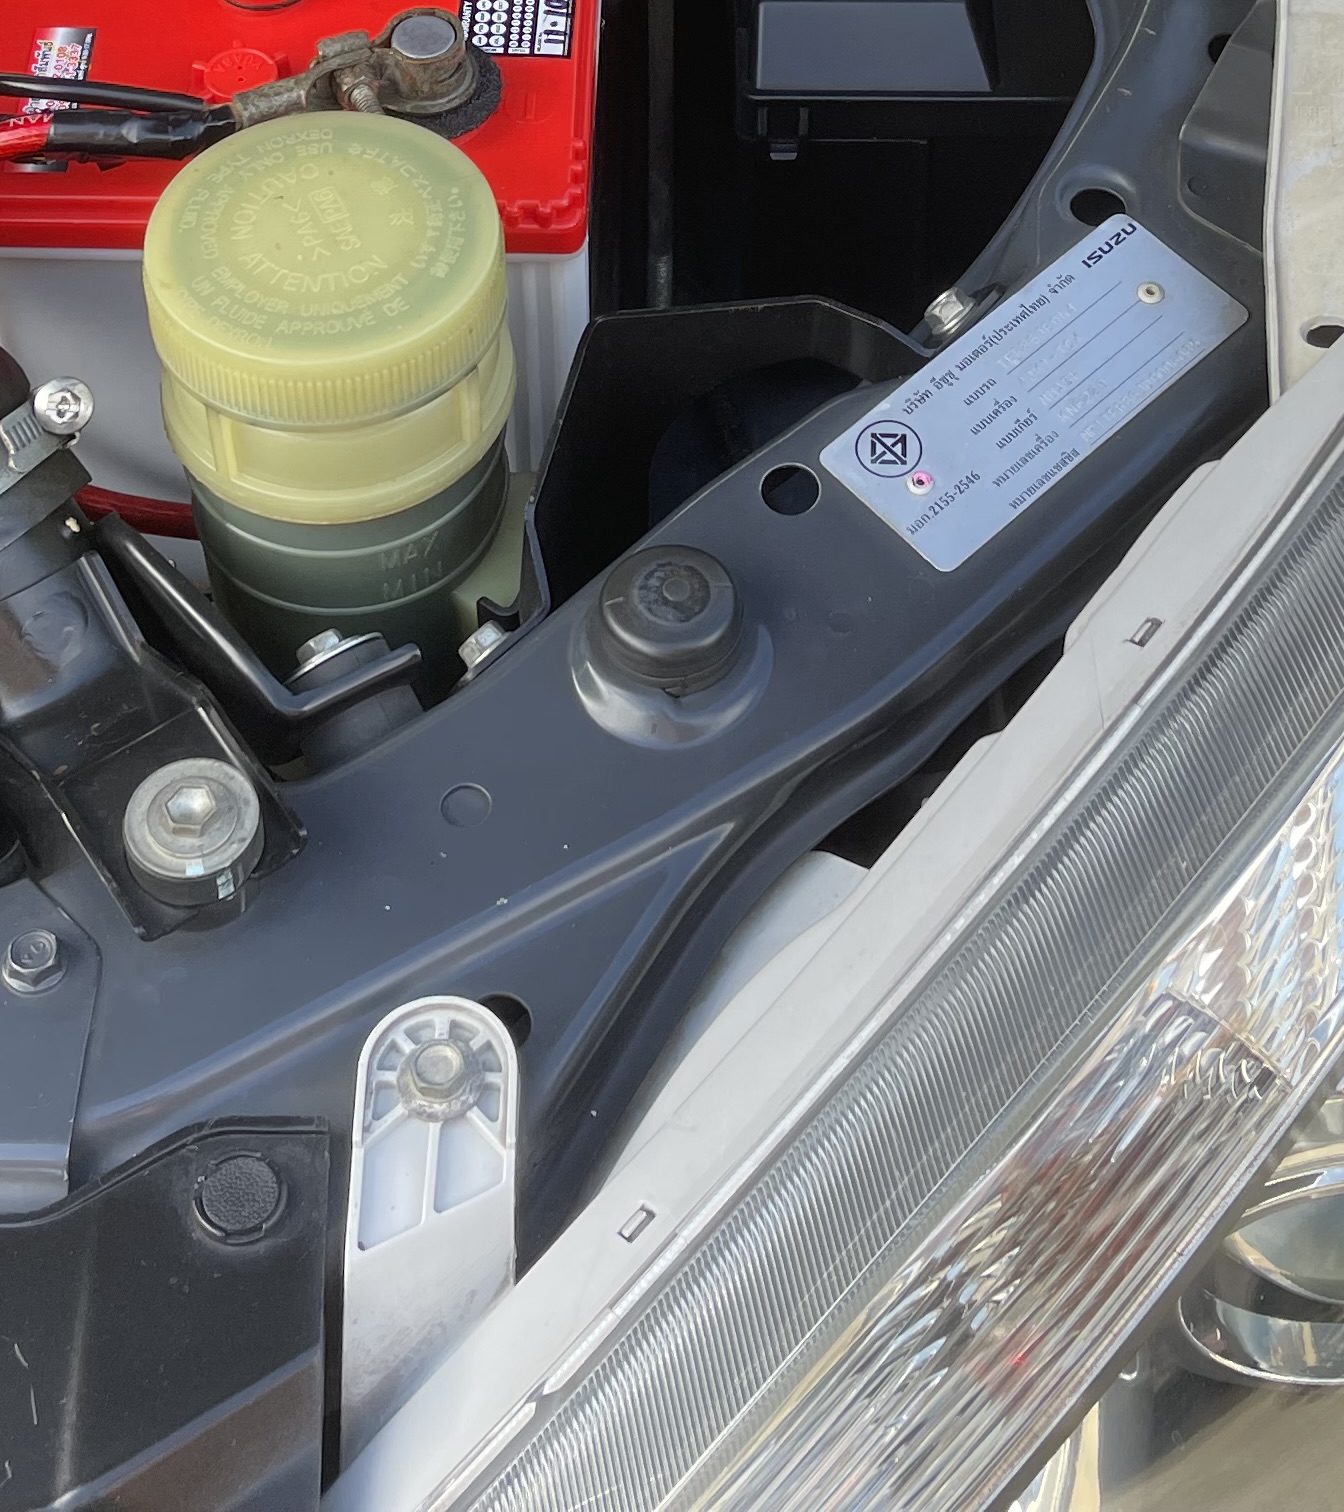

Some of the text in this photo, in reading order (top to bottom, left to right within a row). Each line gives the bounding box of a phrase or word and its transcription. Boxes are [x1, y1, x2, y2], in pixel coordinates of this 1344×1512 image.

[231, 162, 319, 241] CAUTION
[1081, 222, 1138, 269] ISUZU
[238, 251, 389, 293] ATTENTION
[902, 384, 934, 417] บริษัท
[1048, 272, 1076, 300] จำกัด
[962, 376, 998, 408] แบบรถ
[969, 393, 1020, 437] แบบเครื่อง
[904, 471, 982, 536] มอก.2155-2546
